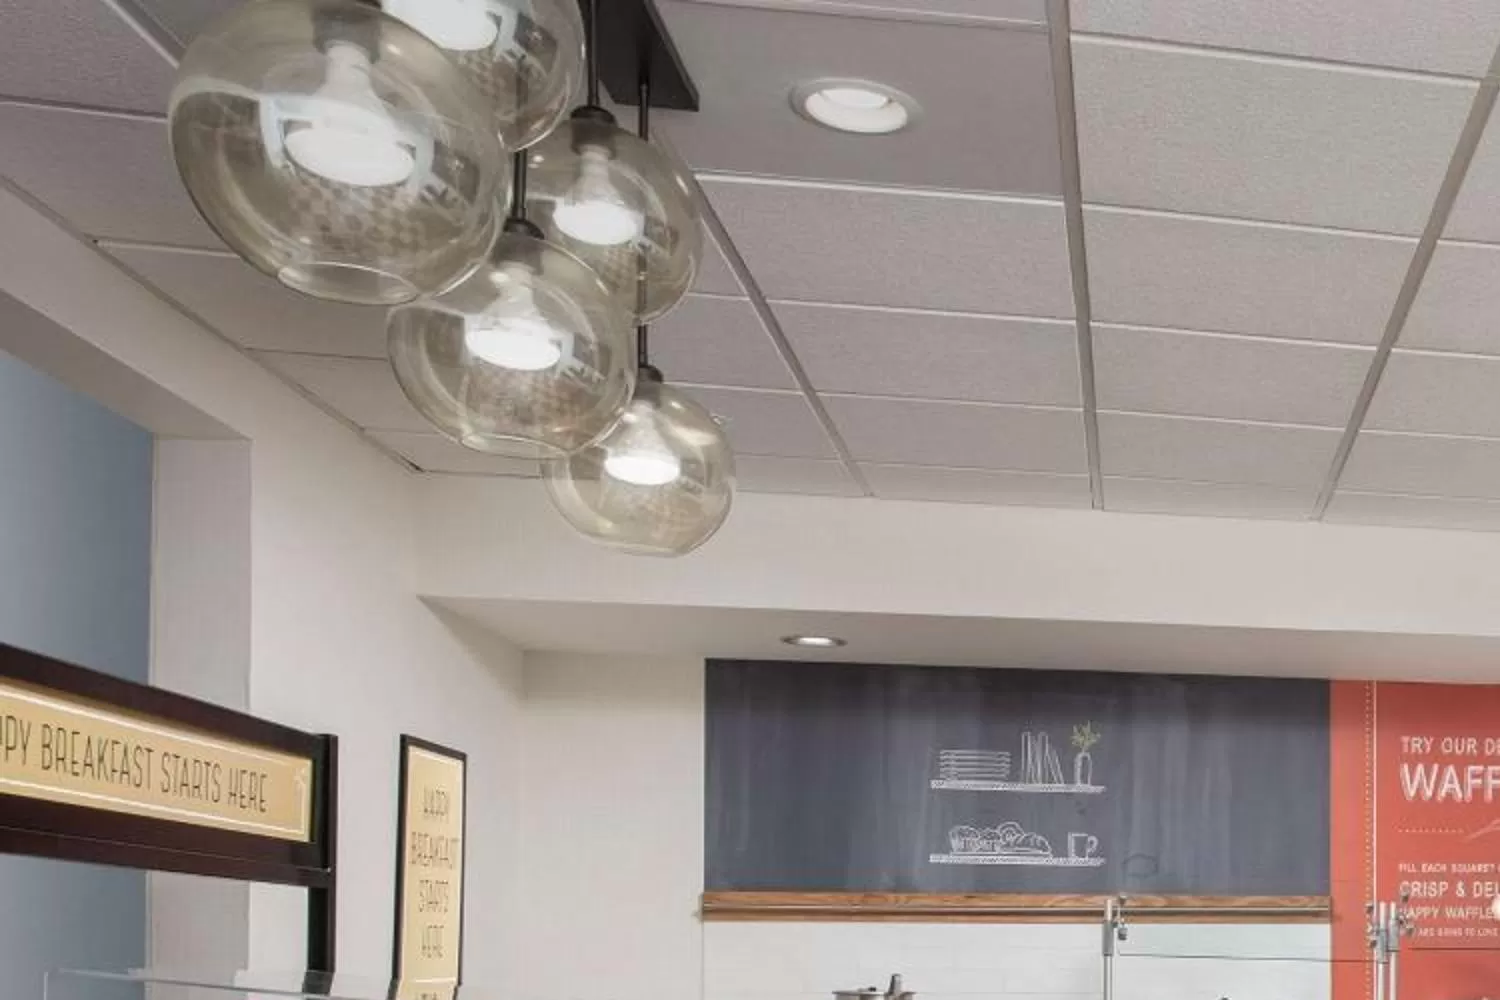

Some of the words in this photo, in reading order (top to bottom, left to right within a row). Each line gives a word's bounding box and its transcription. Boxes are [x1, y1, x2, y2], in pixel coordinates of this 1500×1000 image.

[1401, 736, 1433, 753] TRY
[1441, 737, 1477, 755] OUR
[0, 715, 32, 766] PY
[41, 723, 154, 790] BREAKFAST
[160, 751, 222, 803] STARTS
[228, 768, 268, 813] HERE
[1400, 881, 1449, 897] CRISP
[1456, 881, 1465, 897] &
